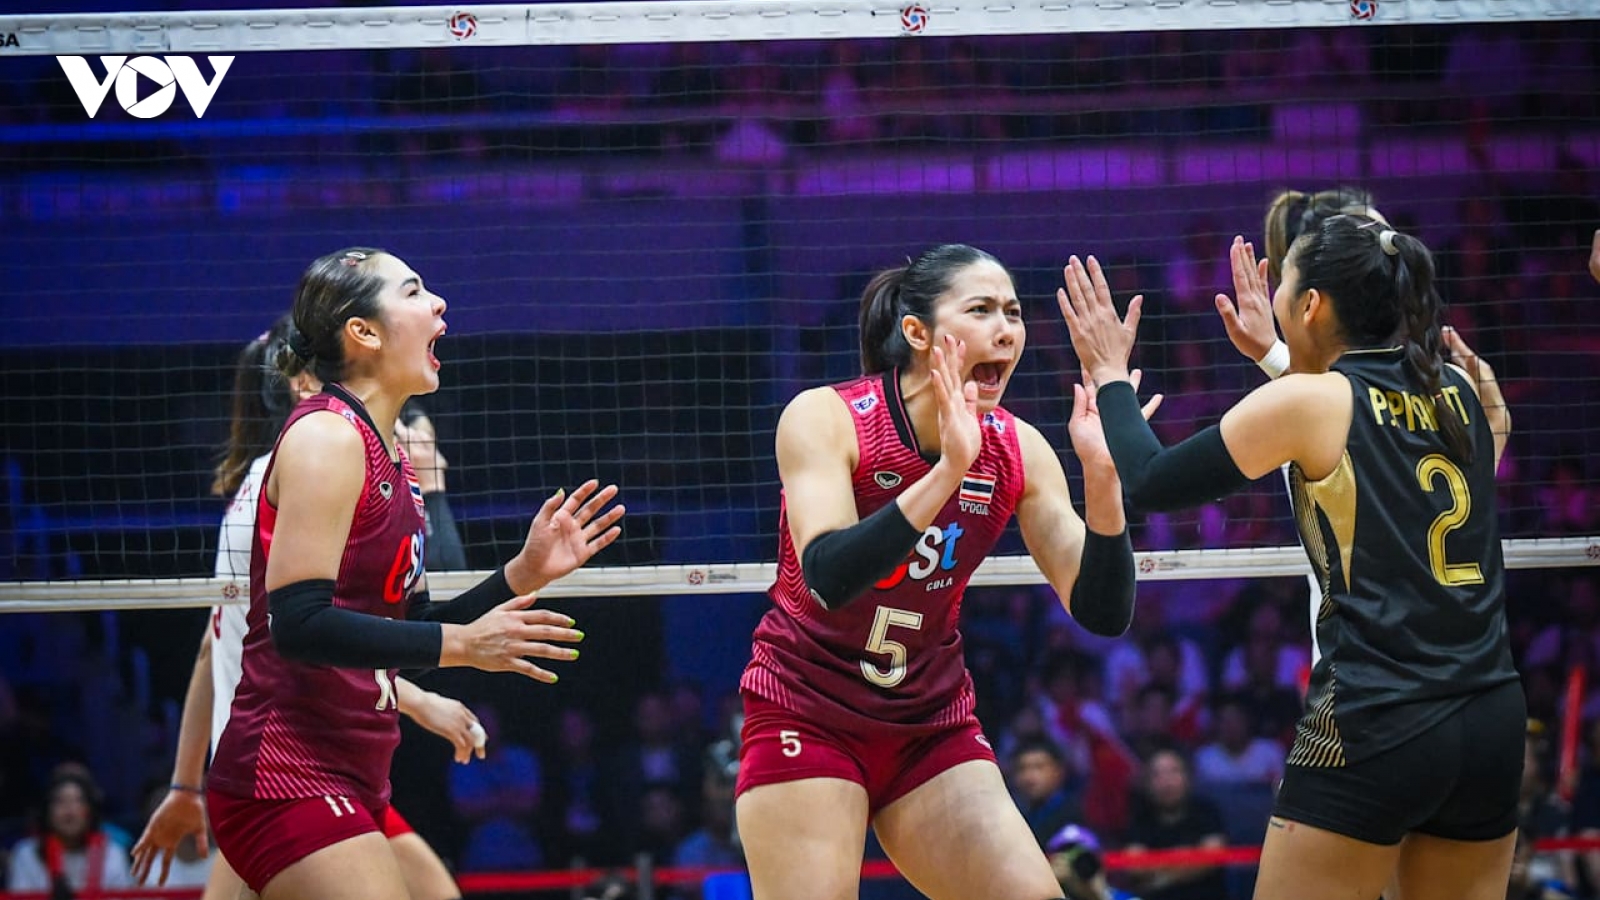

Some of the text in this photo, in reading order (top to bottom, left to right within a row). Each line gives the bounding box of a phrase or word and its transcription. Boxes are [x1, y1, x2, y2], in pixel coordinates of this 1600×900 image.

[959, 501, 989, 515] THA
[1416, 454, 1485, 587] 2
[926, 577, 953, 592] COLA
[860, 605, 924, 688] 5
[780, 730, 802, 757] 5
[324, 795, 356, 817] 11
